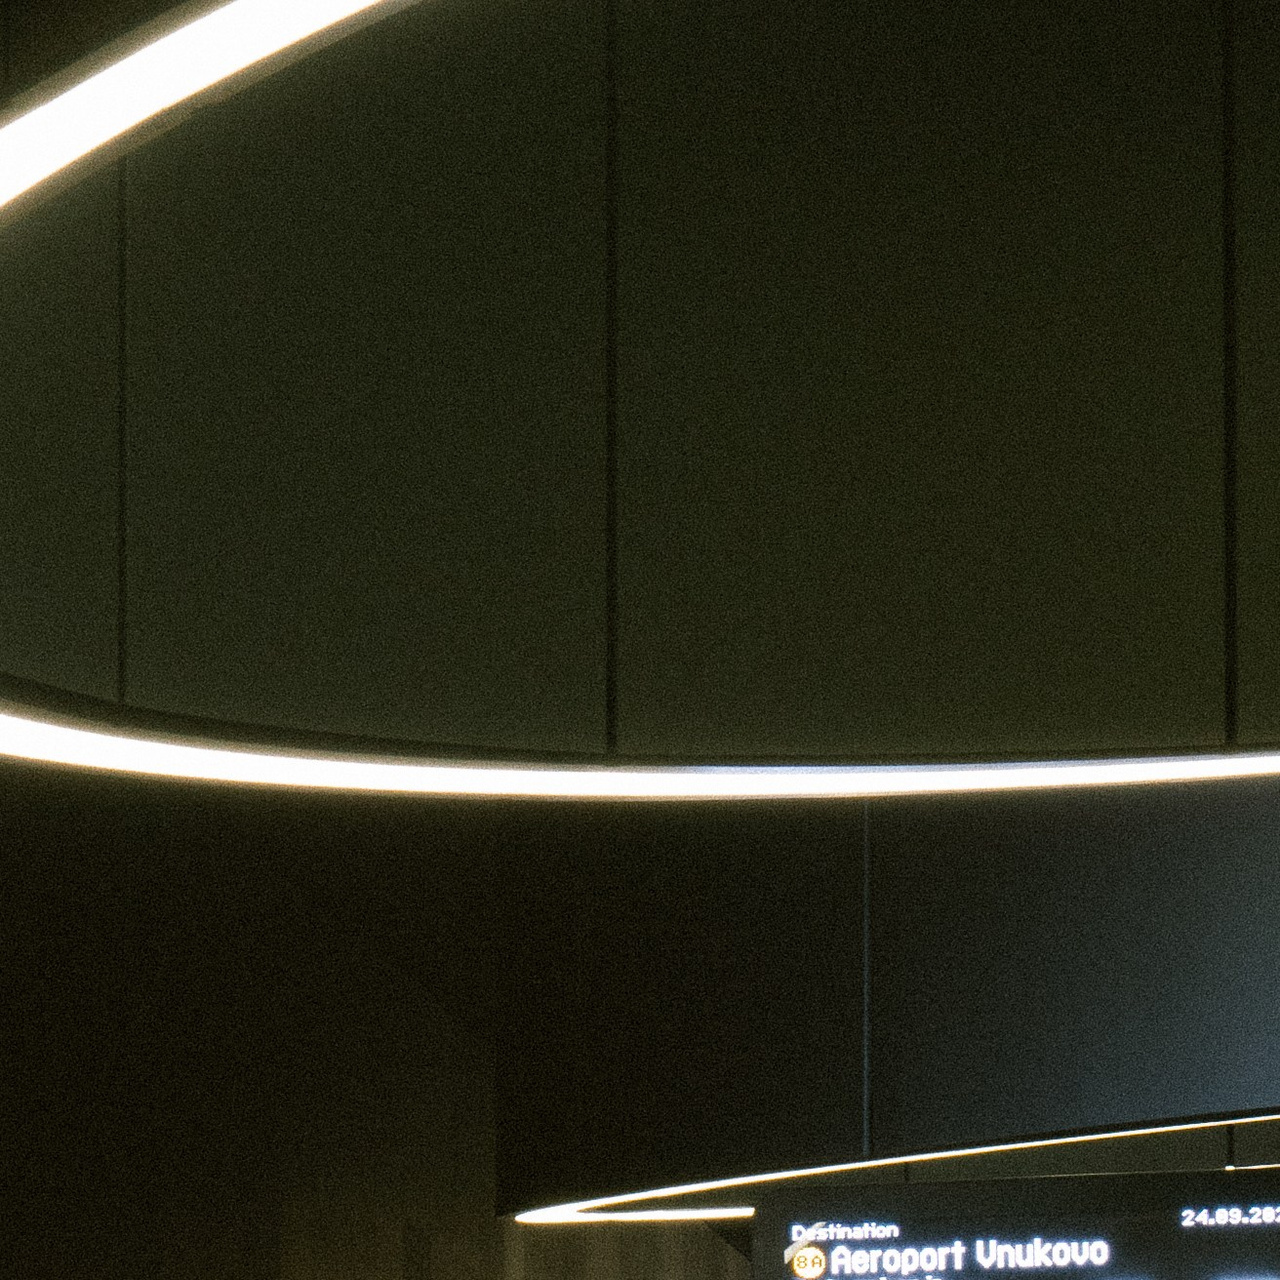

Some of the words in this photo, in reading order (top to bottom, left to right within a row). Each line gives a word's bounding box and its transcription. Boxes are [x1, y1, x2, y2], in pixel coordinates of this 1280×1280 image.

[791, 1221, 900, 1241] Destination
[830, 1240, 966, 1276] Aeroport
[975, 1237, 1110, 1269] Vnukovo
